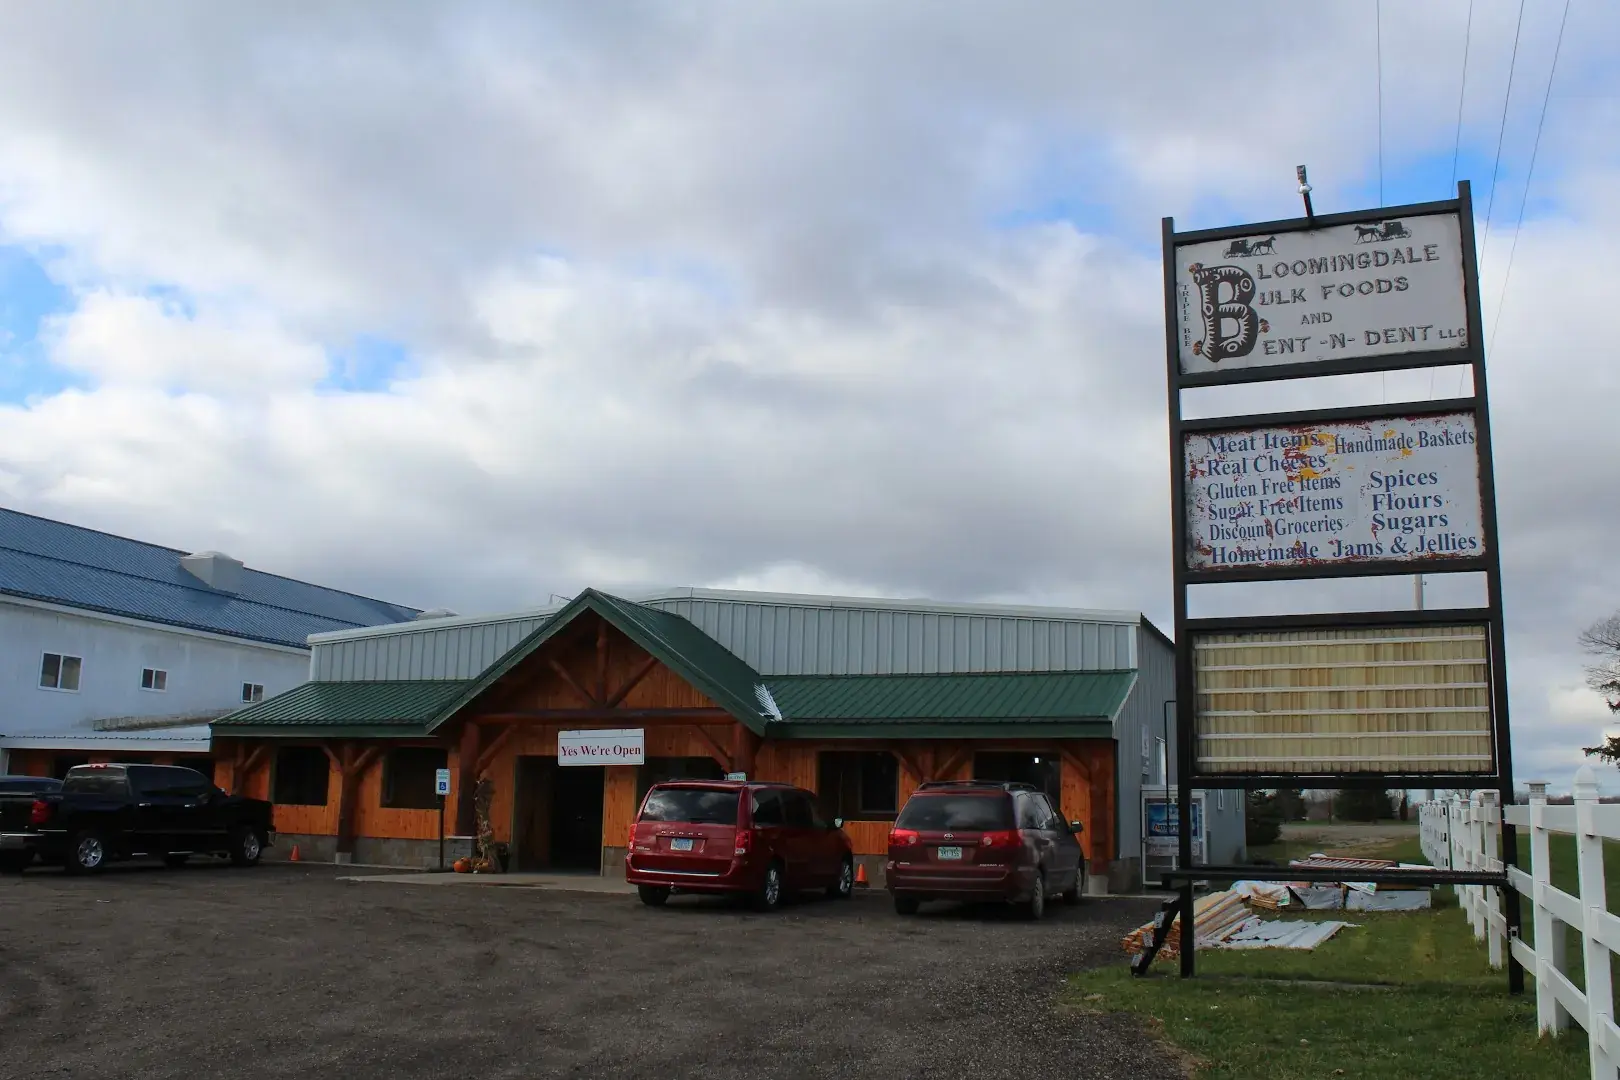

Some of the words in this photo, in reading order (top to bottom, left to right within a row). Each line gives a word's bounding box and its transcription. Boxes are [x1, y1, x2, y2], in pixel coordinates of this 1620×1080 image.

[1320, 276, 1410, 300] FOODS
[1180, 284, 1190, 322] TRIPLE
[1300, 311, 1333, 326] AND
[1183, 328, 1191, 347] BEE
[1364, 324, 1434, 347] DENT
[1437, 327, 1466, 340] LLC
[1207, 435, 1256, 455] Meat
[1263, 432, 1319, 450] Items
[1333, 432, 1414, 455] Handmade
[1418, 428, 1475, 449] Baskets
[1207, 456, 1248, 477] Real
[1252, 453, 1327, 474] Cheeses
[1207, 481, 1257, 501] Gluten
[1261, 477, 1295, 496] Free
[1299, 474, 1342, 493] Items
[1369, 469, 1438, 492] Spices
[1207, 501, 1255, 524] Sugar
[1259, 497, 1295, 517] Free
[1299, 494, 1343, 514] Items
[1371, 492, 1443, 512] Flours
[1209, 520, 1273, 542] Discount
[1274, 515, 1343, 537] Groceries
[1371, 512, 1449, 534] Sugars
[1210, 541, 1320, 564] Homemade
[1332, 538, 1384, 558] Jams
[1390, 535, 1408, 554] &
[1414, 531, 1477, 554] Jellies
[561, 745, 578, 756] Yes
[580, 745, 611, 756] We're
[613, 744, 641, 758] Open
